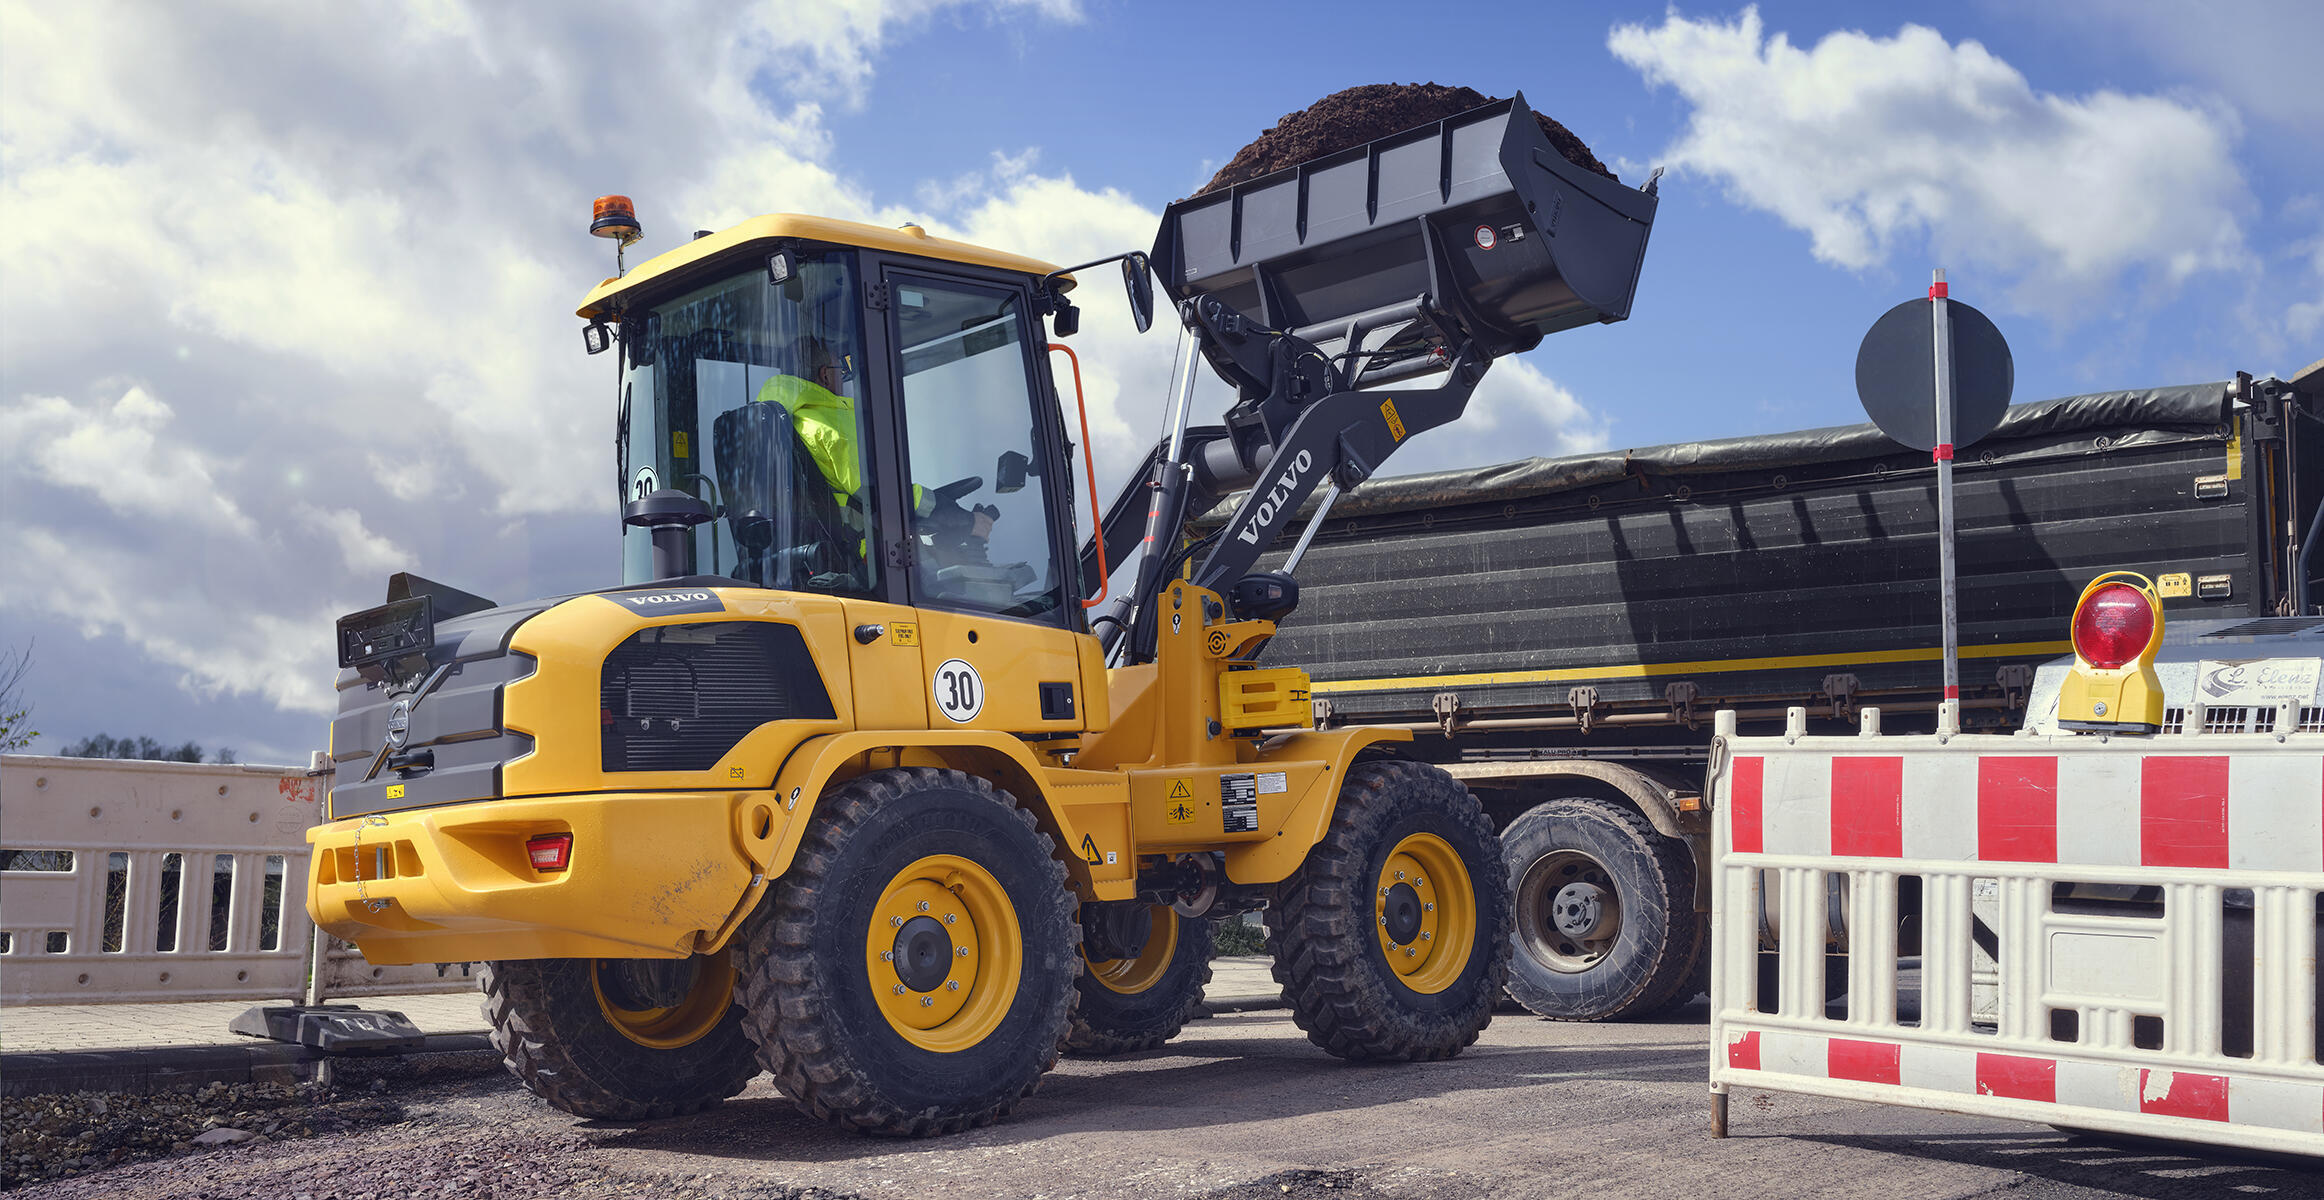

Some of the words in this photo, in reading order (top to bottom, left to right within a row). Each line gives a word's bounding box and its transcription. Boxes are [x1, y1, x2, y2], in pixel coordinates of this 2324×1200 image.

[1237, 449, 1312, 545] VOLVO
[626, 593, 708, 605] VOLVO
[942, 670, 975, 711] 30
[2257, 666, 2313, 685] Elenz
